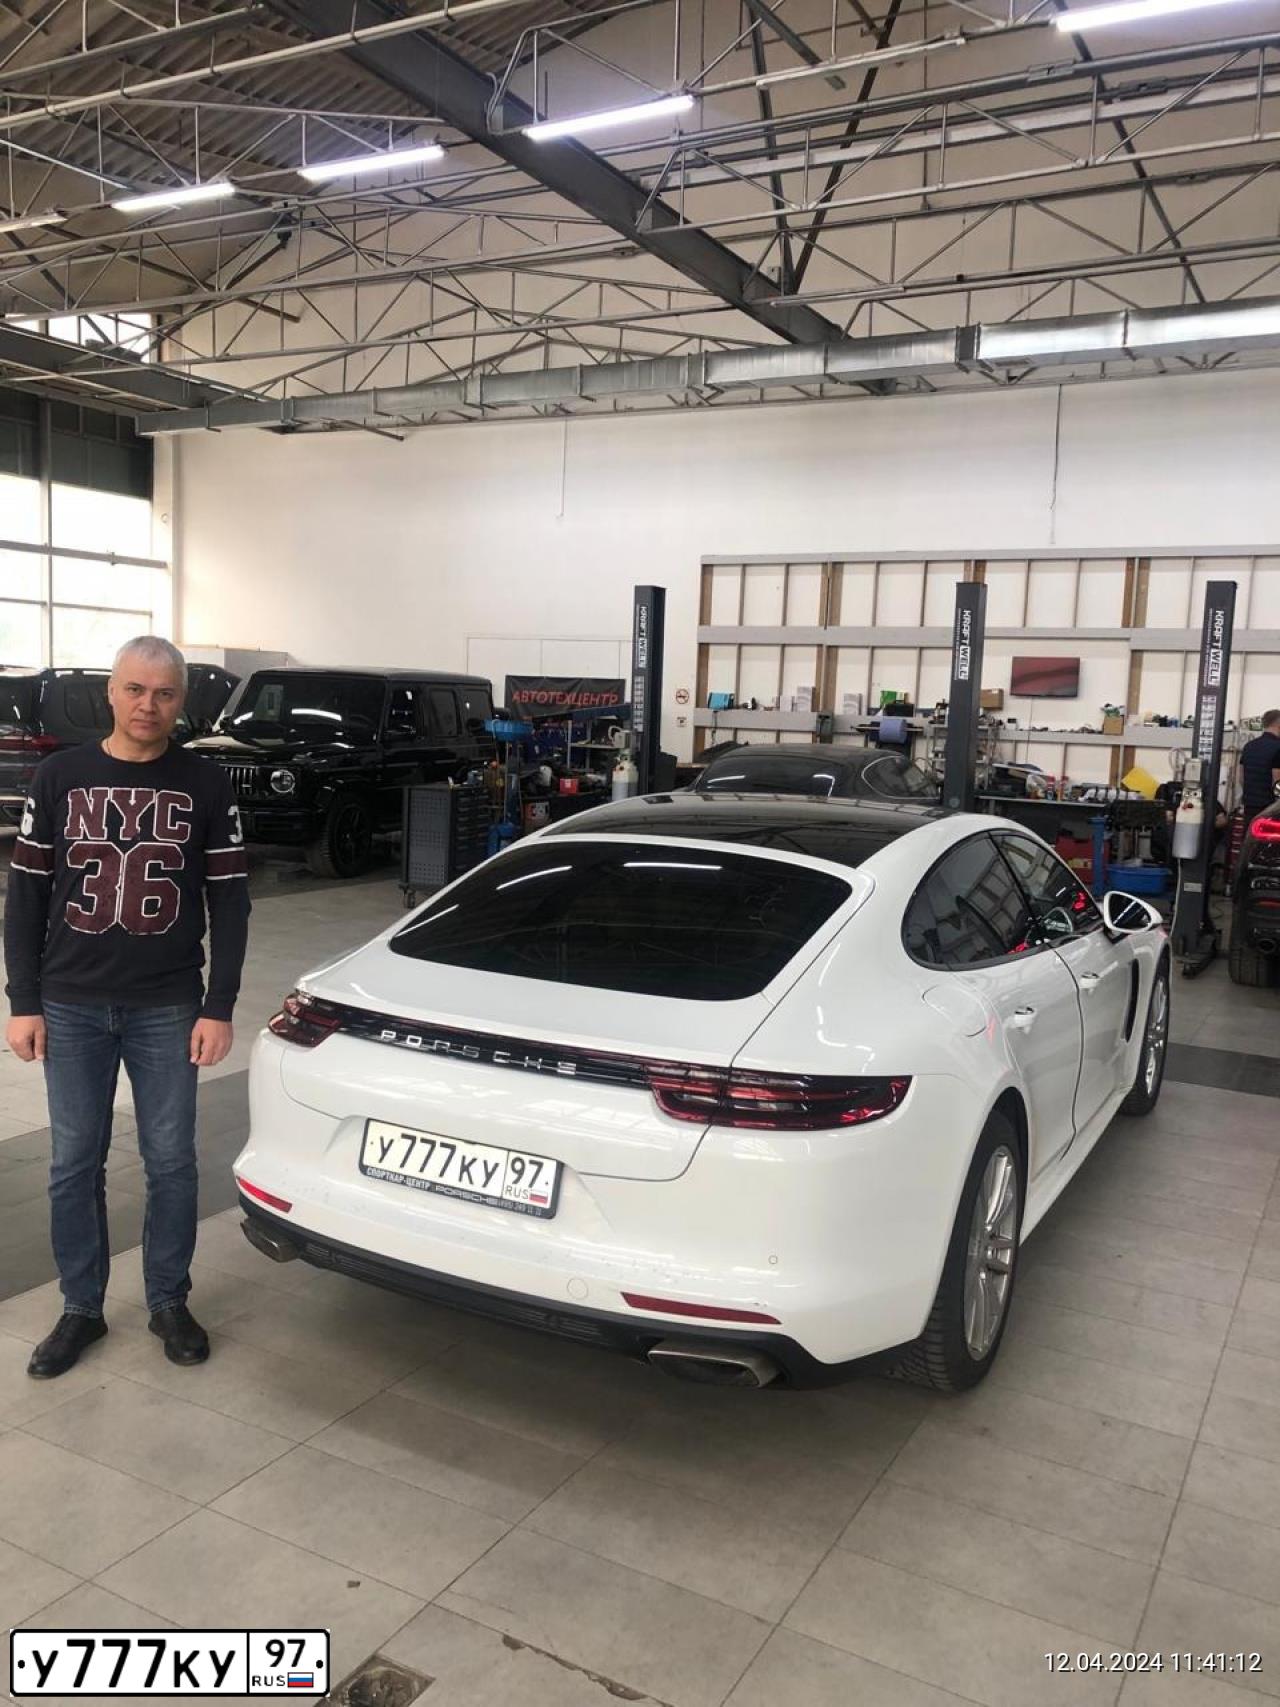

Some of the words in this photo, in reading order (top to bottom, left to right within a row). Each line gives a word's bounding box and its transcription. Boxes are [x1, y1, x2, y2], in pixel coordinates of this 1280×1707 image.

[512, 690, 619, 705] АВТОТЕХЦЕНТР
[64, 787, 192, 843] NYC
[64, 841, 184, 935] 36
[380, 1029, 577, 1075] PORSCHE
[378, 1133, 500, 1188] У777КУ
[510, 1156, 544, 1188] 97
[504, 1184, 529, 1200] RUS
